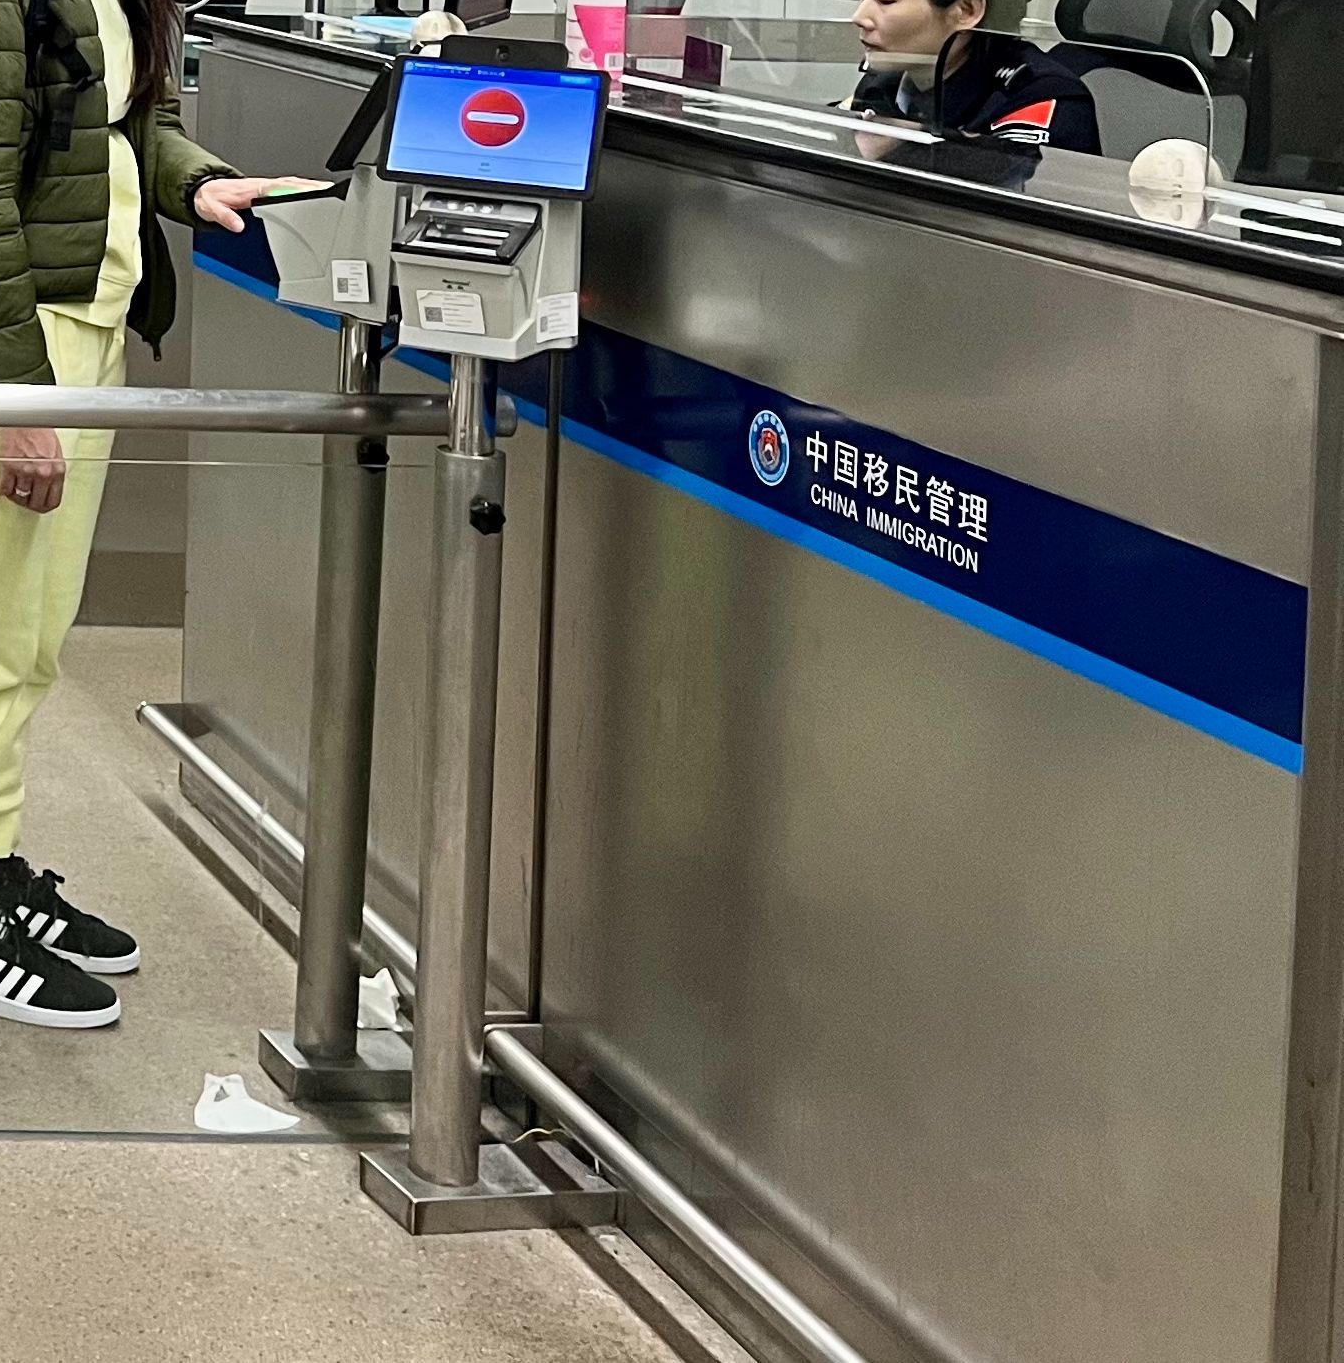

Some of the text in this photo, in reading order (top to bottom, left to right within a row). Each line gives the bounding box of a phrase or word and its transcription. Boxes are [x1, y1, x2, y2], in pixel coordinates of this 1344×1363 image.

[806, 430, 988, 542] 中国移民管理
[810, 483, 979, 574] CHINA IMMIGRATION
